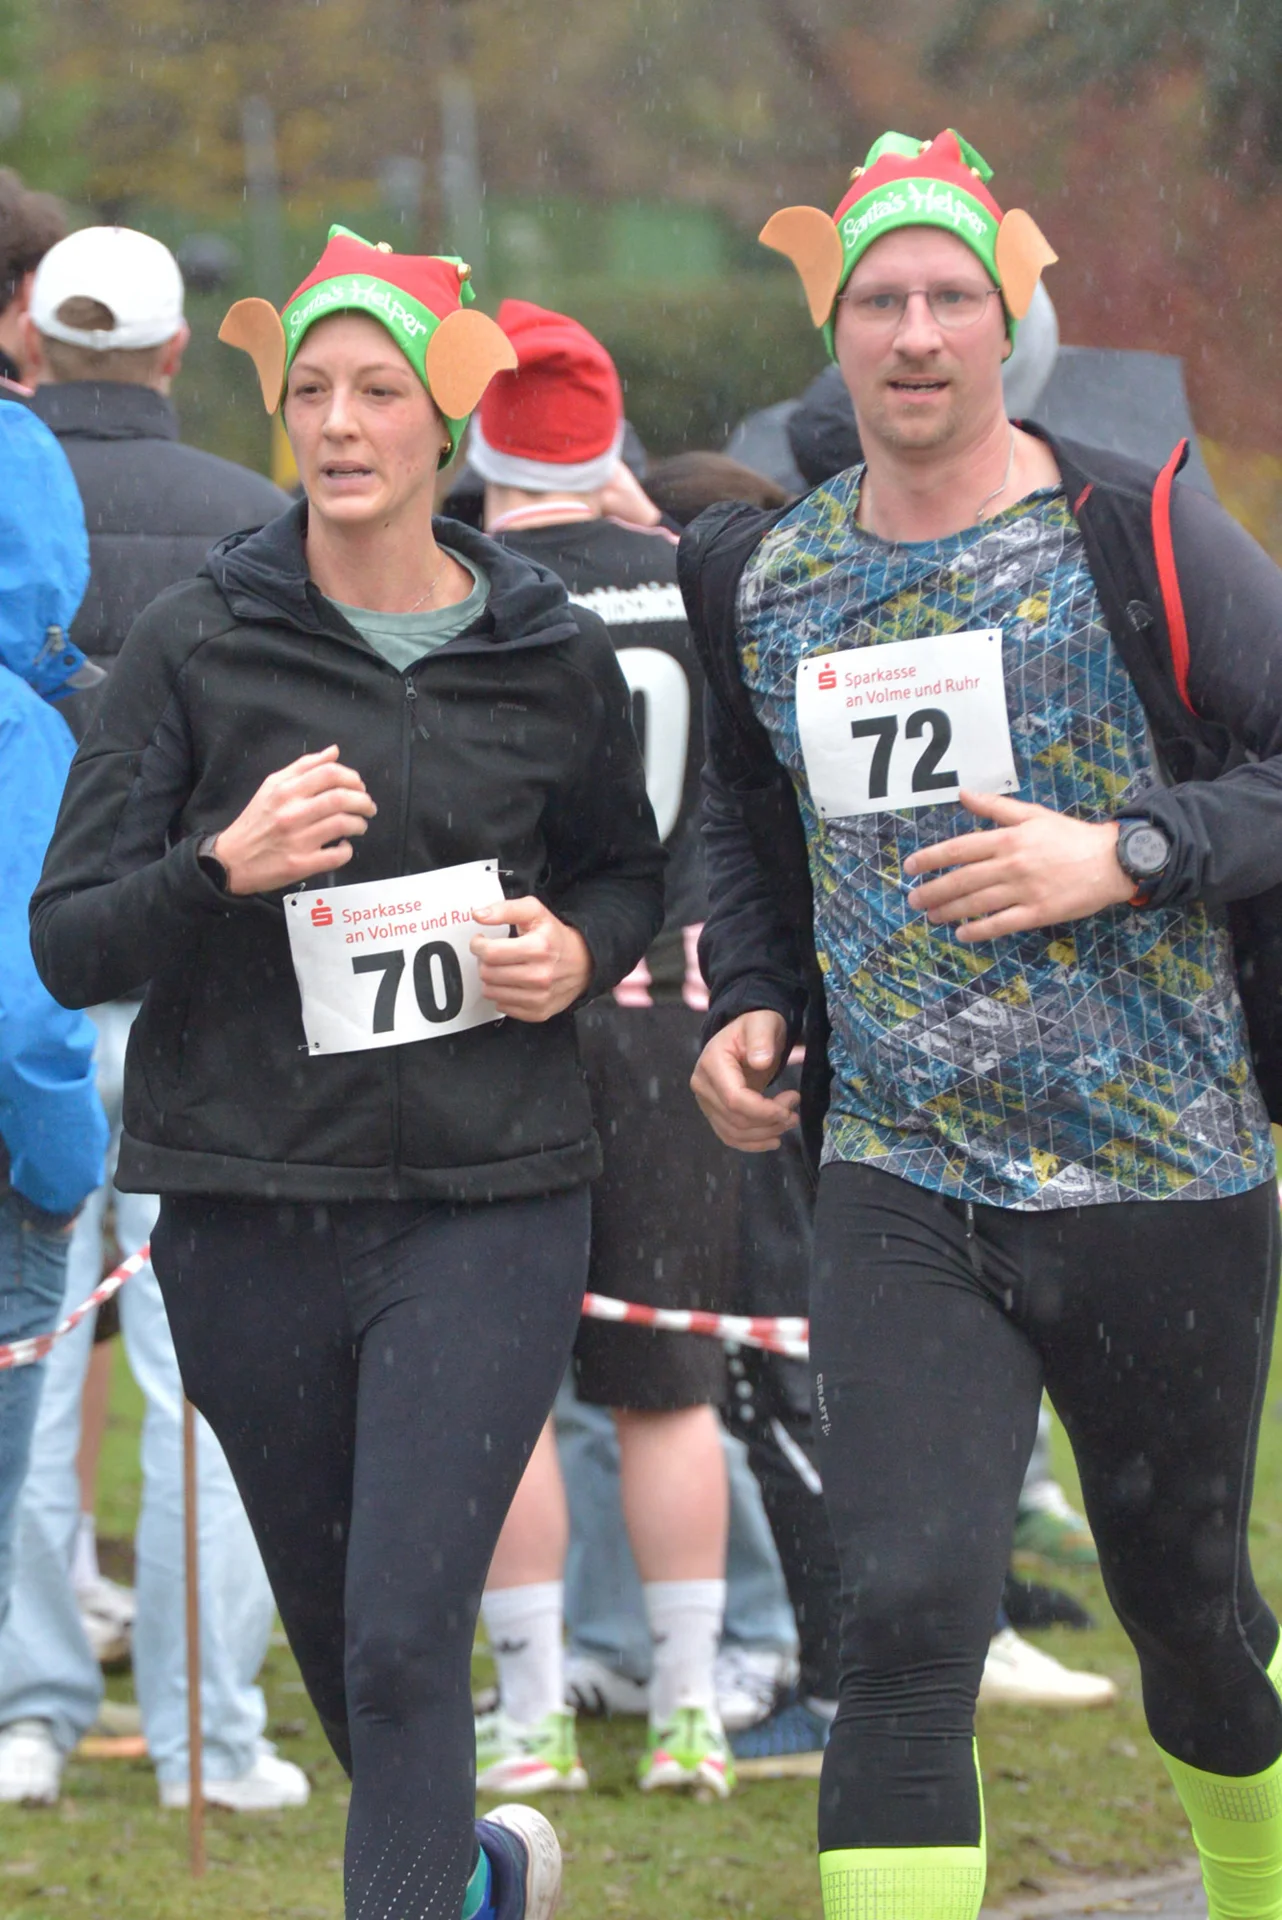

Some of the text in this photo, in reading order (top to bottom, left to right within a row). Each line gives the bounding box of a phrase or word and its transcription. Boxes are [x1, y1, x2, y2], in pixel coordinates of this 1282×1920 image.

[843, 182, 988, 248] Santa's Helper
[290, 279, 427, 338] Santa's Helper
[844, 665, 917, 689] Sparkasse
[846, 676, 981, 708] an Volme und Ruhr
[850, 707, 960, 800] 72
[341, 899, 423, 925] Sparkasse
[345, 906, 475, 944] an Volme und Ru
[351, 940, 464, 1035] 70
[816, 1373, 829, 1422] CRAFT
